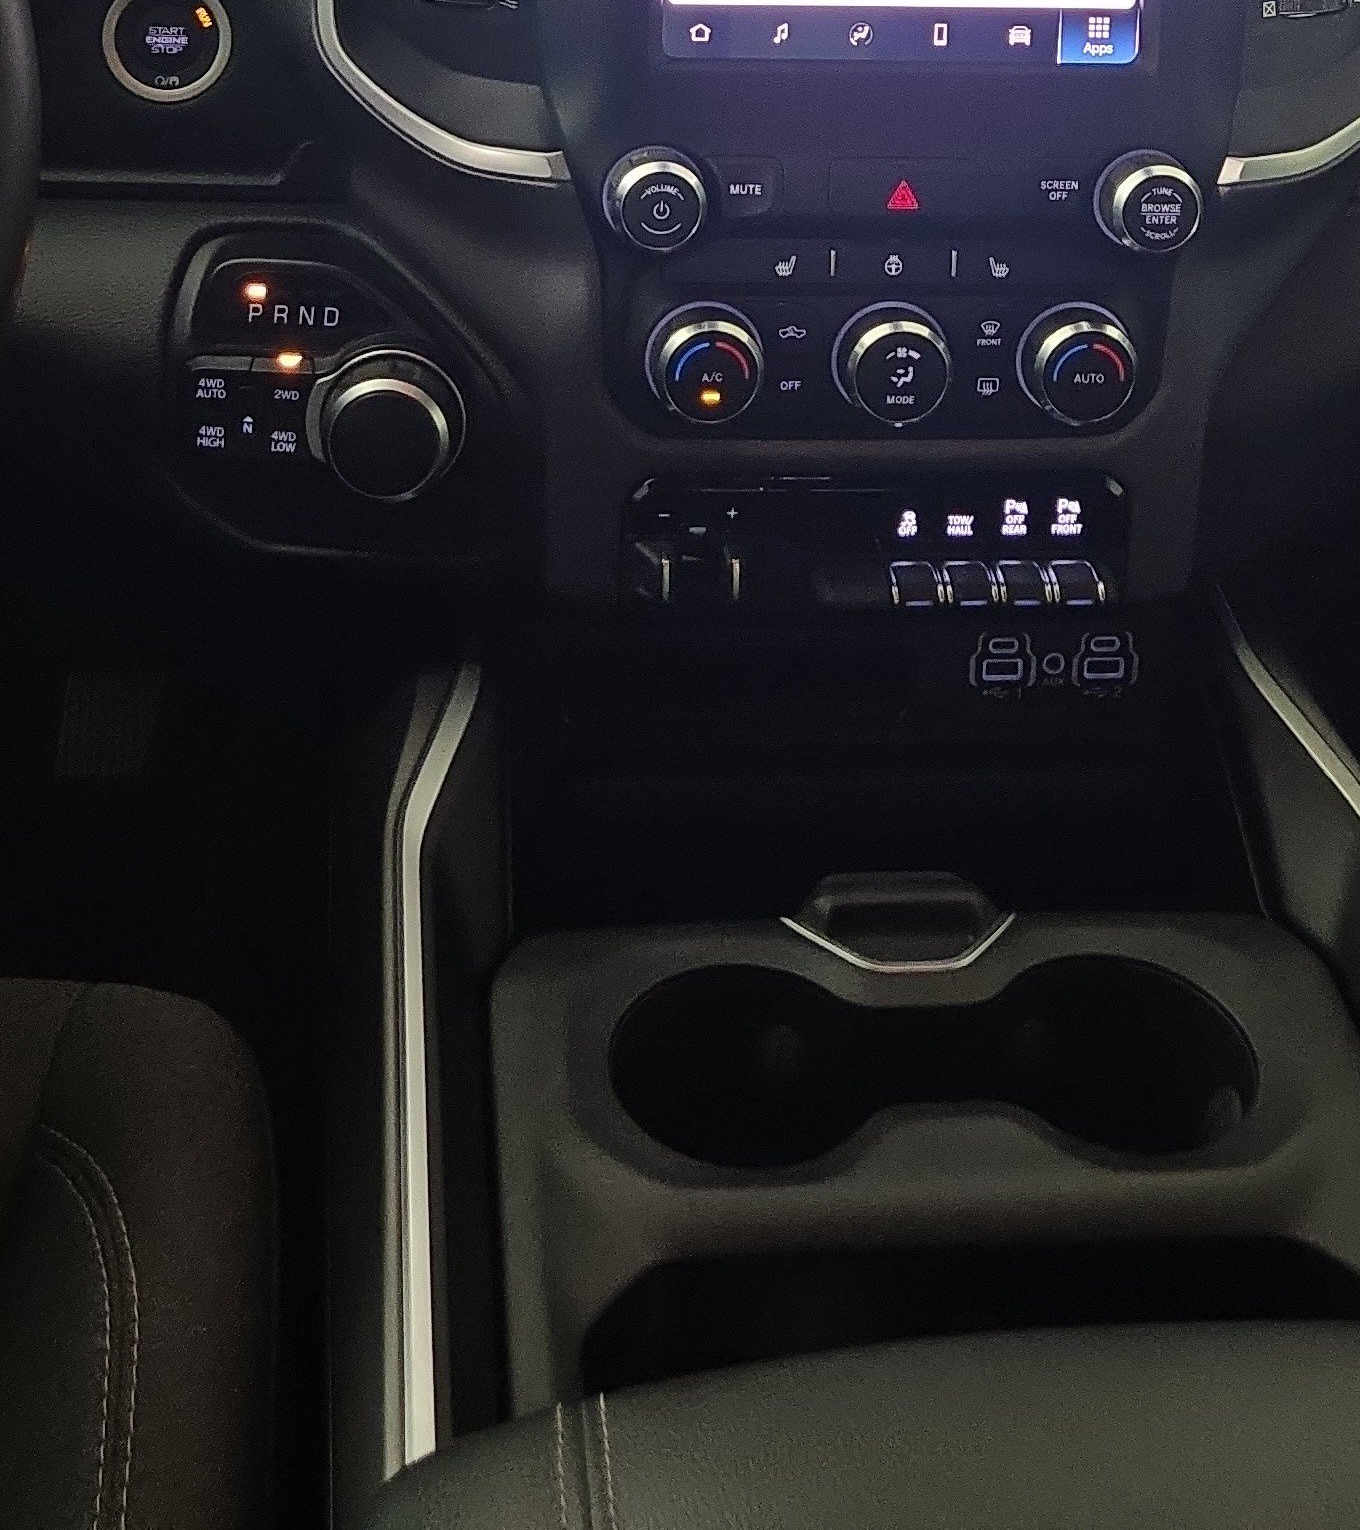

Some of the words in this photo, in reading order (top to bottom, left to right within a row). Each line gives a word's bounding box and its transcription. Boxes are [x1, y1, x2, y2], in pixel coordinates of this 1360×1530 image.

[148, 26, 186, 36] START
[145, 35, 189, 45] ENGINE
[150, 45, 184, 55] STOP
[1083, 42, 1114, 57] Apps
[644, 184, 679, 196] VOLUME
[729, 183, 763, 197] MUTE
[1040, 179, 1079, 192] SCREEN
[1151, 186, 1174, 197] TUNE
[1048, 190, 1069, 201] OFF
[1140, 203, 1182, 213] BROWSE
[1145, 215, 1177, 225] ENTER
[1144, 229, 1177, 241] SCROLL
[248, 304, 263, 324] P
[273, 304, 289, 324] R
[298, 305, 315, 326] N
[323, 306, 340, 327] D
[976, 338, 1002, 347] FRONT
[198, 377, 226, 389] 4WD
[701, 371, 724, 383] A/C
[1074, 372, 1105, 385] AUTO
[780, 380, 802, 392] OFF
[195, 388, 227, 400] AUTO
[273, 389, 300, 401] 2WD
[886, 394, 915, 406] MODE
[198, 424, 226, 437] 4WD
[242, 421, 253, 434] N
[270, 429, 297, 442] 4WD
[196, 436, 226, 449] HIGH
[270, 440, 296, 453] LOW
[946, 514, 974, 525] TOW/
[1005, 514, 1026, 525] OFF
[1057, 513, 1078, 524] OFF
[897, 525, 918, 537] OFF
[946, 524, 974, 536] HAUL
[1001, 524, 1028, 536] REAR
[1050, 523, 1083, 535] FRONT
